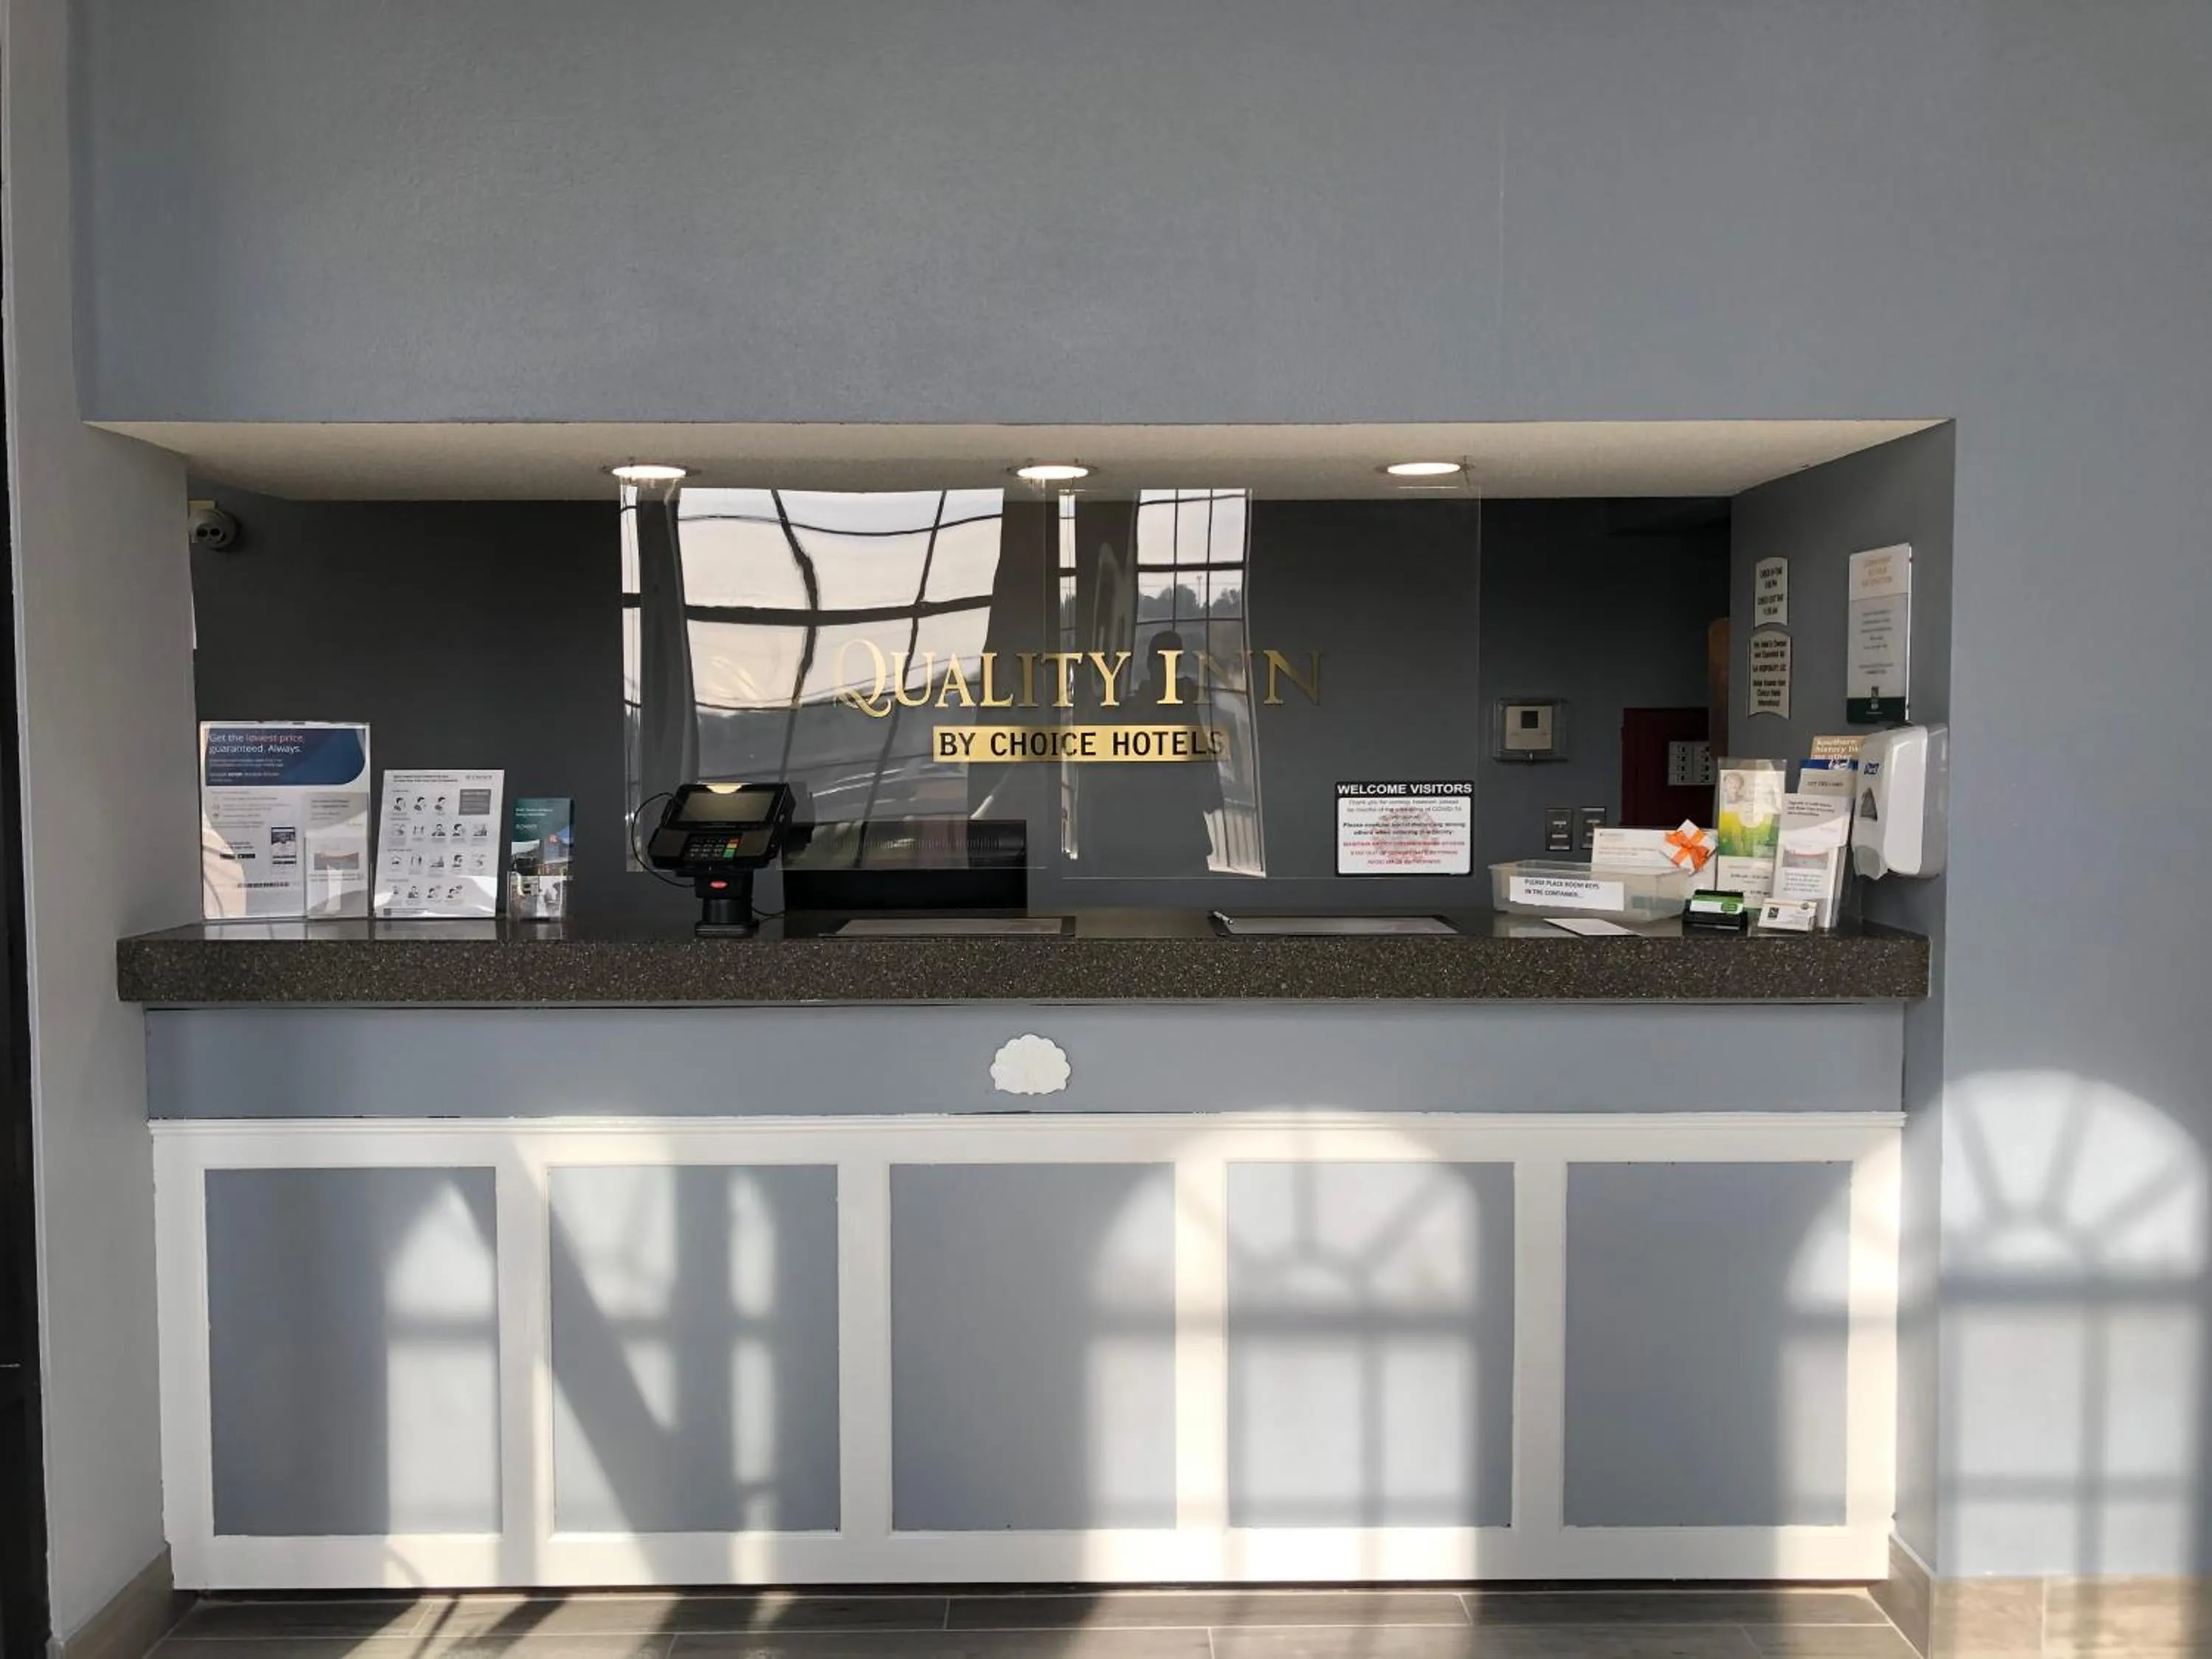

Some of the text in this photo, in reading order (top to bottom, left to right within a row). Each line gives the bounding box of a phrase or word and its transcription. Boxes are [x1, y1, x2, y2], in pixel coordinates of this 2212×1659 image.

[833, 639, 1322, 718] QUALITY INN
[209, 734, 226, 742] Get
[228, 734, 244, 742] the
[246, 734, 277, 742] lowest
[939, 731, 1223, 757] BY CHOICE HOTELS
[268, 745, 302, 754] Always.
[1338, 784, 1472, 794] WELCOME VISITORS
